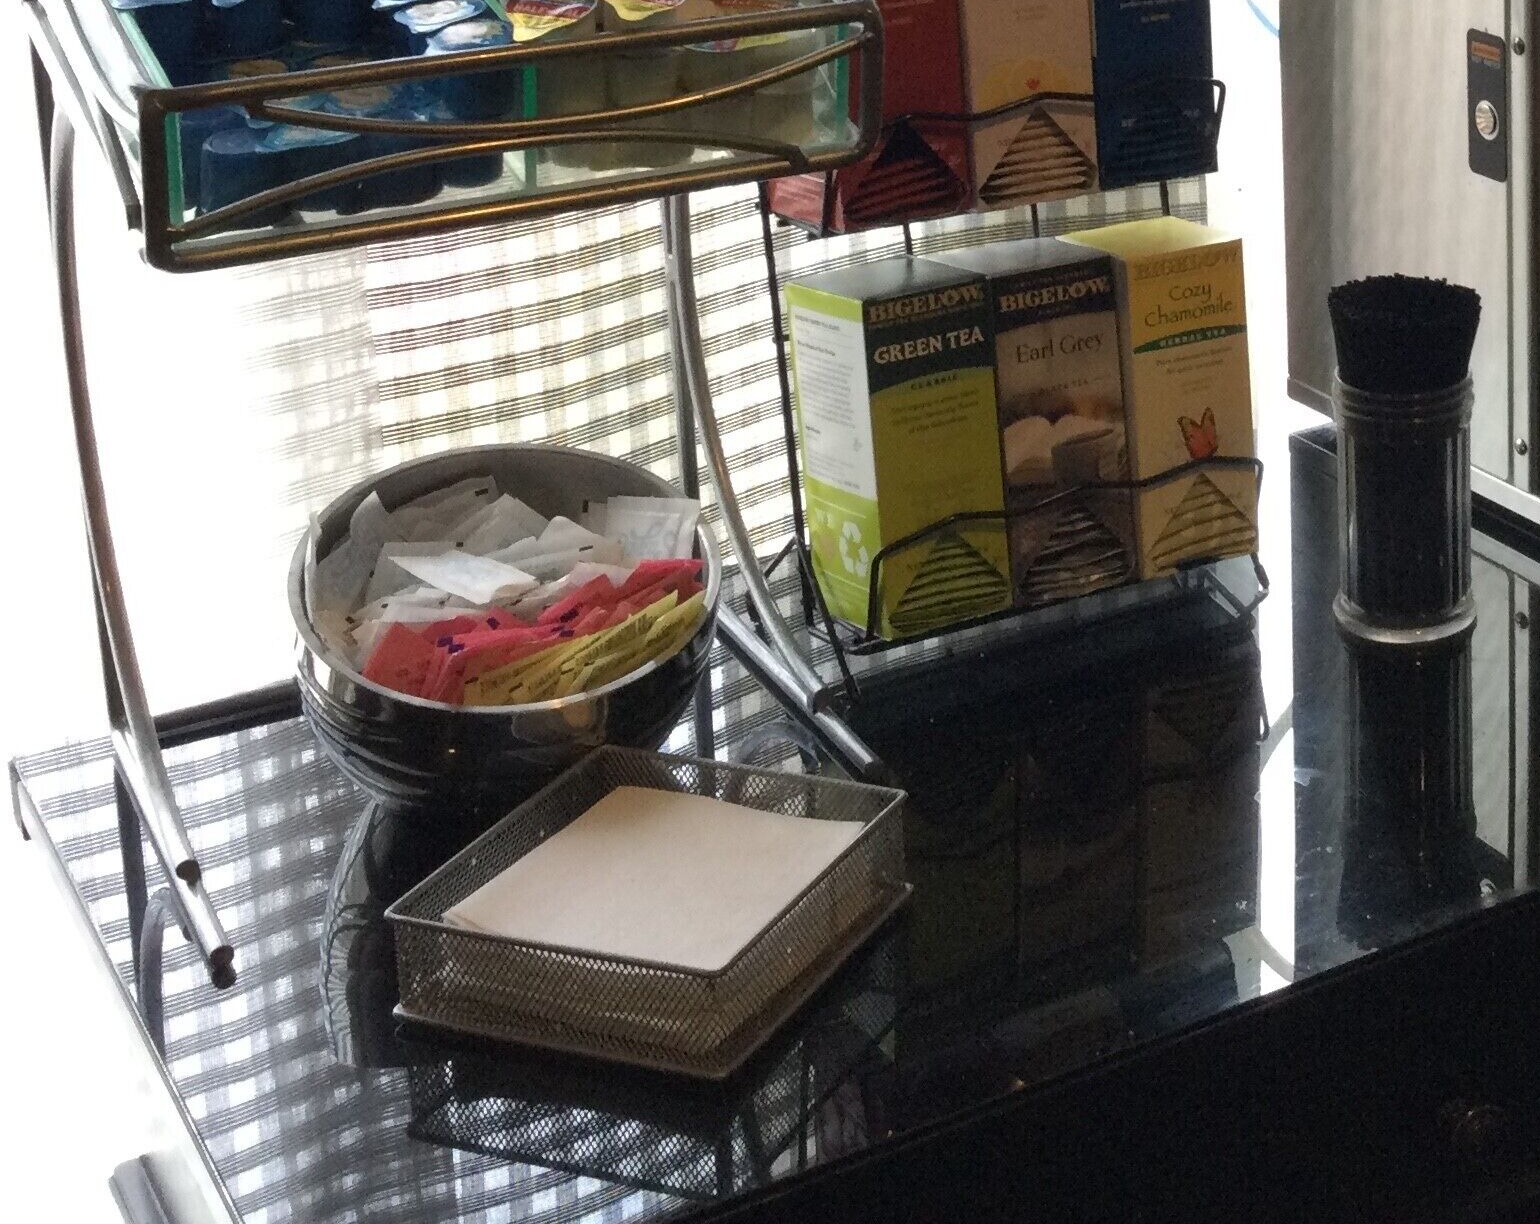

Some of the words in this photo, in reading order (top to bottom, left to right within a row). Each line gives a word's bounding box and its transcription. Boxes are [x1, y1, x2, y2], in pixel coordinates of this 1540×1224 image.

[868, 283, 983, 324] BIGELOW
[999, 276, 1110, 314] BIGELOW
[1169, 282, 1212, 304] Cozy
[873, 333, 943, 365] GREEN
[945, 326, 986, 350] TEA
[1015, 337, 1055, 364] Earl
[1060, 331, 1104, 354] Grey
